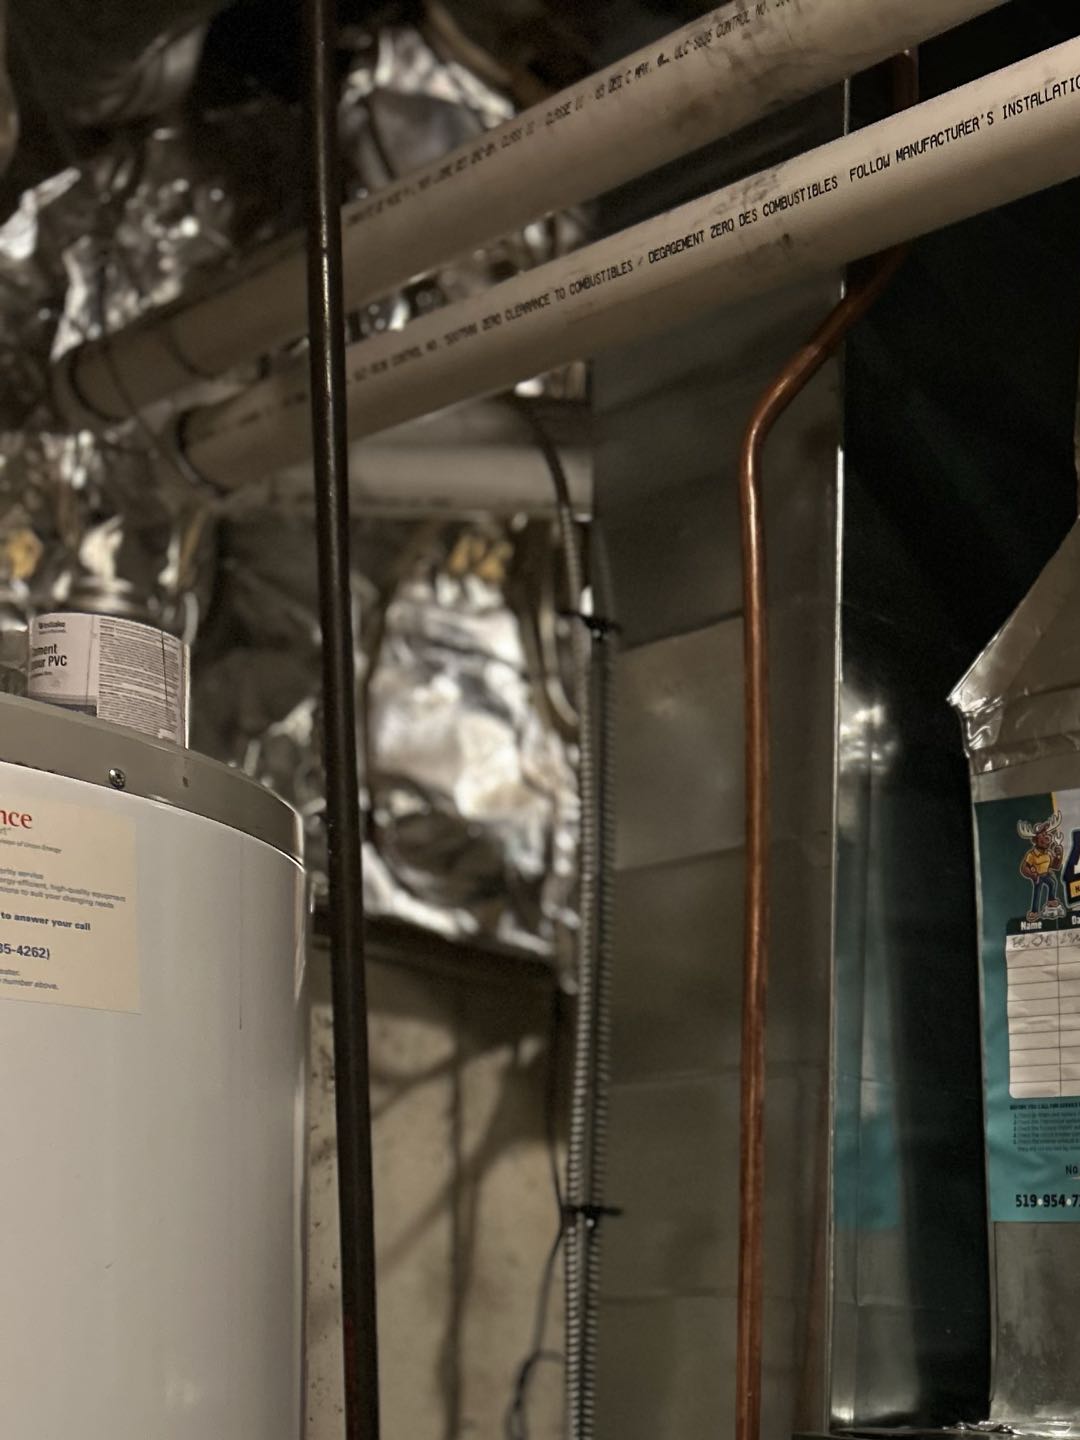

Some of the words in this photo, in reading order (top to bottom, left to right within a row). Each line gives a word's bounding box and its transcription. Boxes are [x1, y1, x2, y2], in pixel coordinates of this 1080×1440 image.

[716, 9, 750, 38] CONTROL
[505, 292, 551, 321] CLEARANCE
[555, 286, 566, 300] TO
[569, 259, 634, 296] COMBUSTIBLES
[648, 229, 705, 264] DEGAGEMENT
[710, 217, 735, 240] ZERO
[739, 210, 758, 227] DES
[762, 175, 838, 217] COMBUSTIBLES
[849, 154, 891, 182] FOLLOW
[896, 111, 995, 162] MANUFACTURER'S
[48, 655, 67, 667] PVC
[1, 911, 11, 920] to
[14, 914, 48, 924] answer
[52, 919, 72, 929] your
[75, 922, 91, 931] call
[1021, 920, 1043, 930] Name
[1065, 1166, 1078, 1175] No
